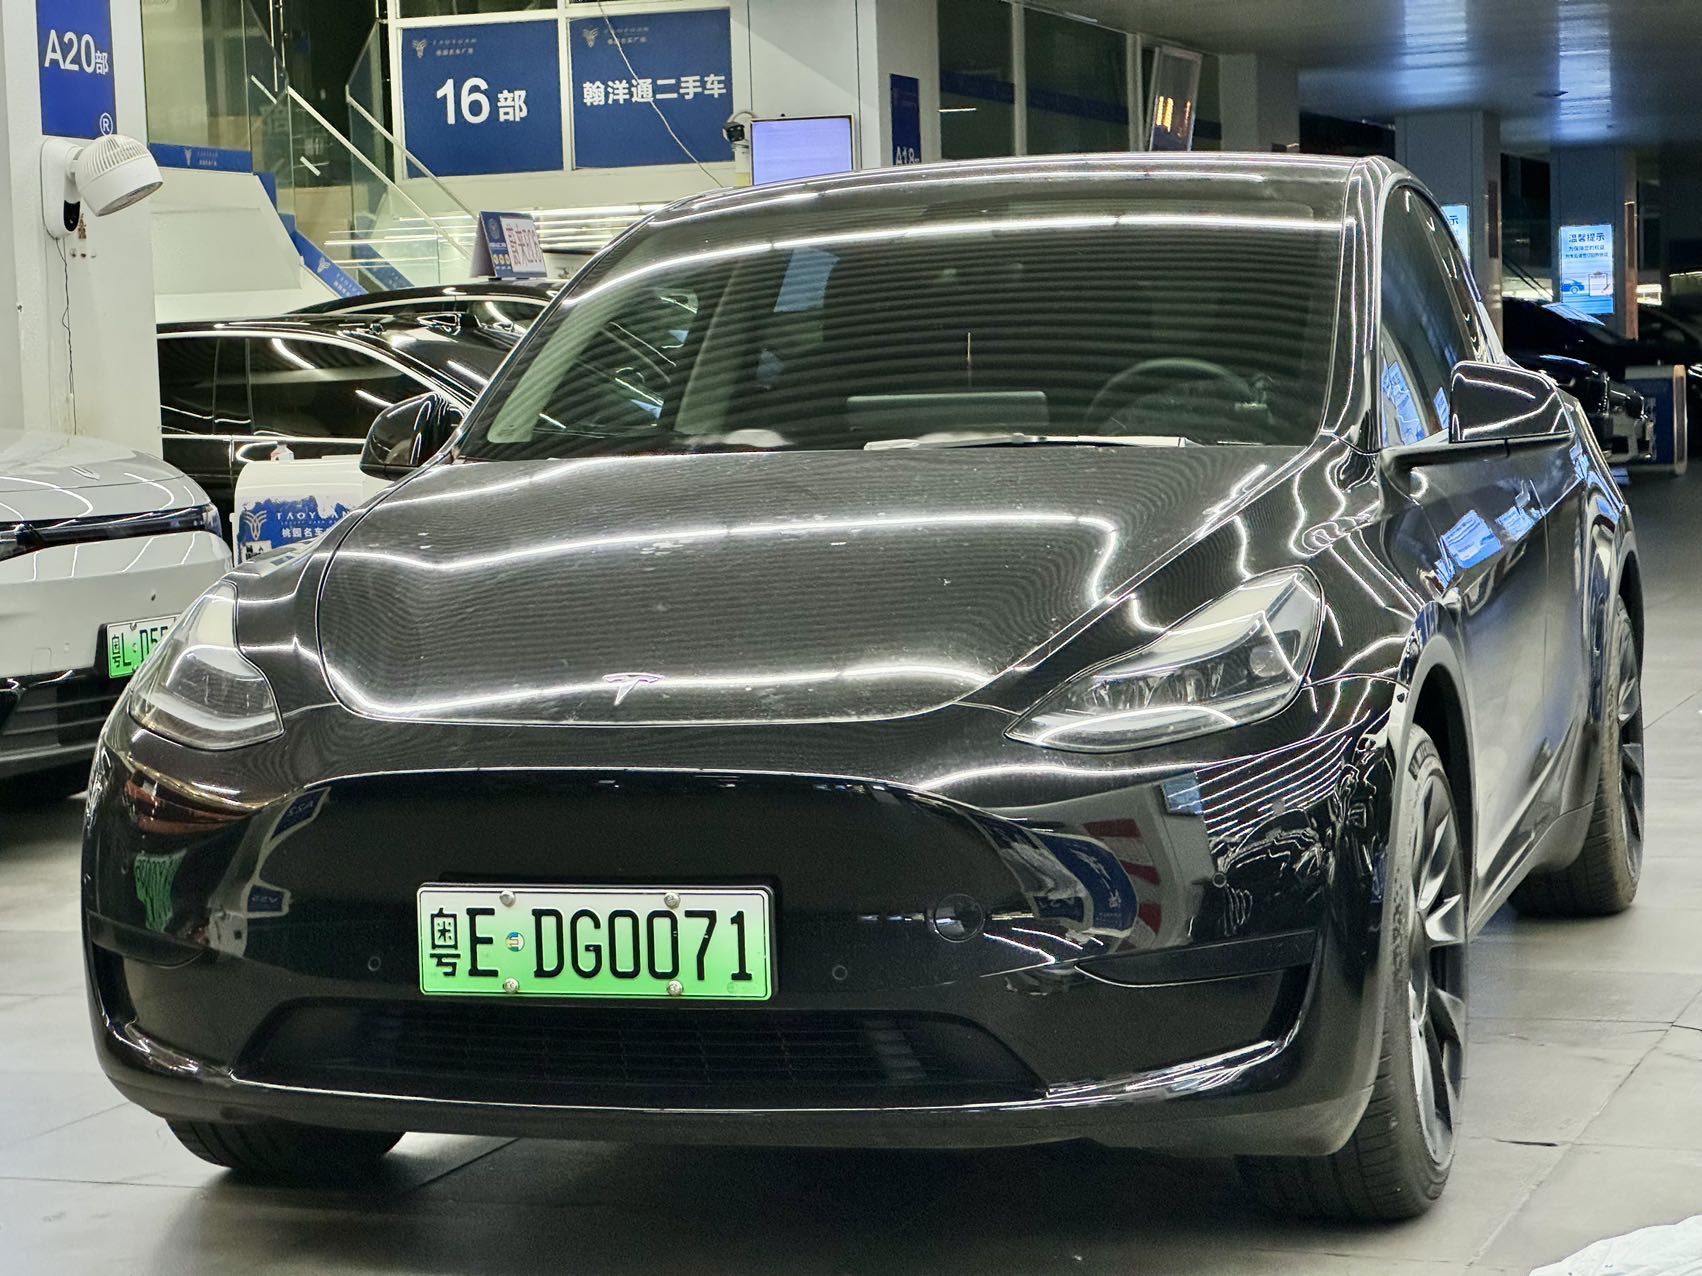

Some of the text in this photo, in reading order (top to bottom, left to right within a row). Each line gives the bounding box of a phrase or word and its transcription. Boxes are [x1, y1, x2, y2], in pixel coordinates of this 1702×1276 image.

[582, 73, 727, 106] 翰洋通二手车
[1568, 232, 1605, 243] 温馨提示
